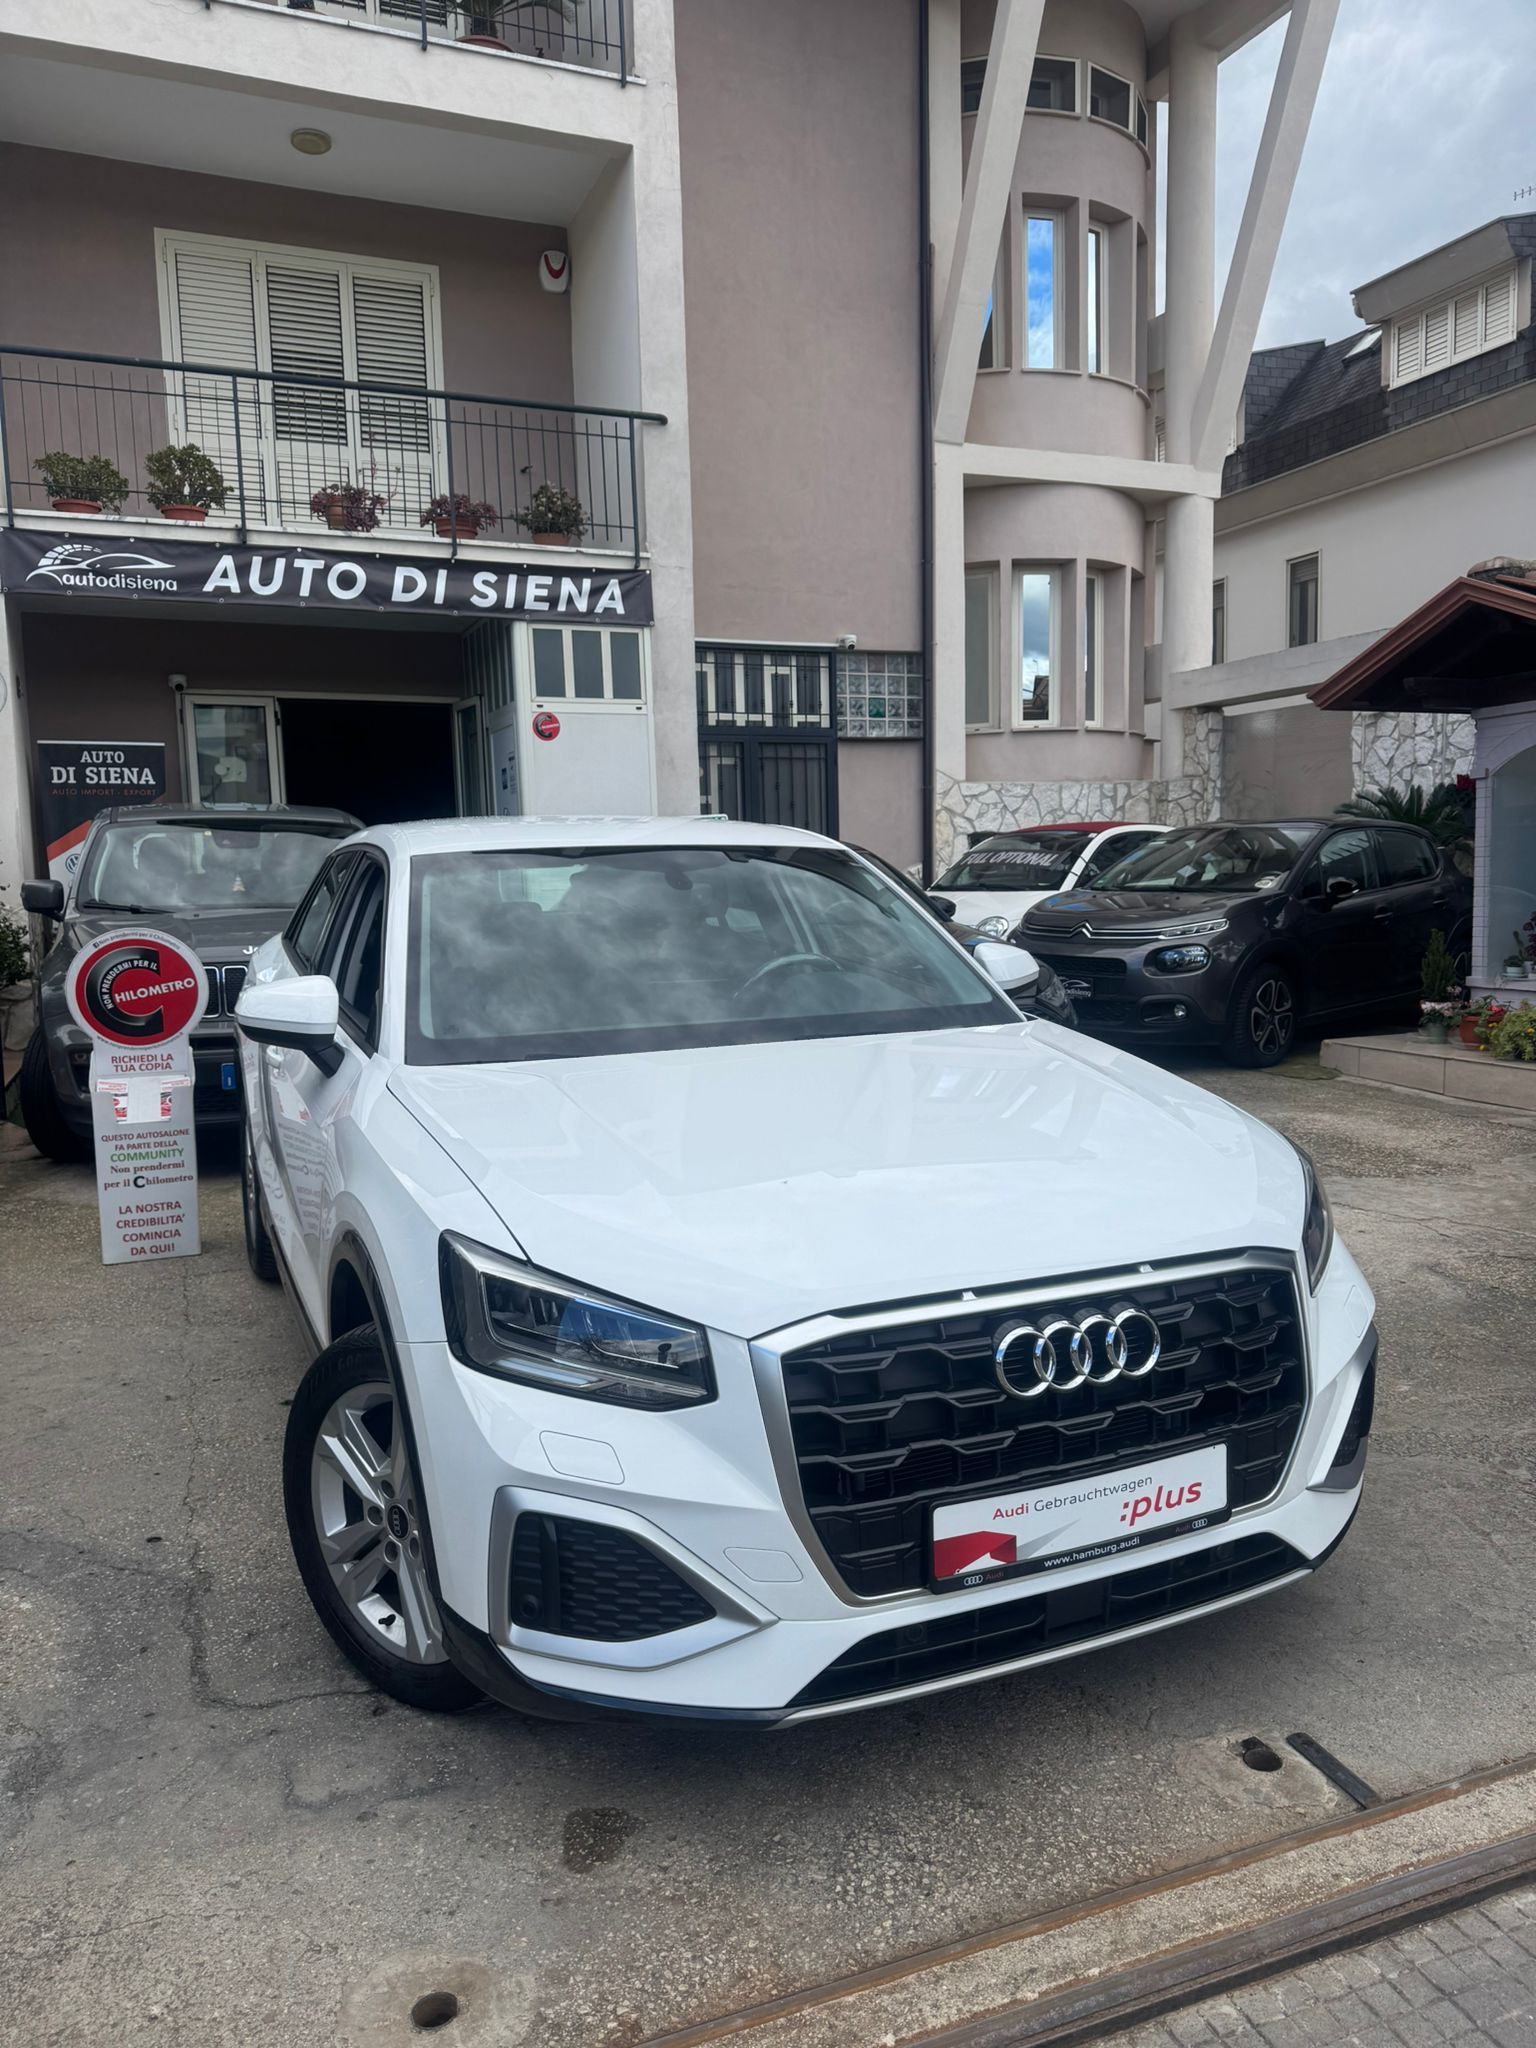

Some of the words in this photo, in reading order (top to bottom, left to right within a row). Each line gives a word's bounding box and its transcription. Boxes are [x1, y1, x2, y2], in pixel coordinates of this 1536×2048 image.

[62, 573, 178, 591] autodisiena
[202, 555, 367, 600] AUTO
[391, 566, 448, 605] DI
[470, 571, 626, 615] SIENA
[80, 751, 125, 764] AUTO
[51, 767, 77, 784] DI
[85, 767, 156, 785] SIENA
[52, 788, 77, 796] AUTO
[81, 788, 115, 796] IMPORT
[124, 788, 156, 796] EXPORT
[960, 852, 993, 866] FULL
[989, 852, 1059, 867] OPTIONAL
[133, 960, 149, 968] PER
[150, 961, 158, 970] IL
[101, 961, 133, 993] PRENDERMI
[102, 994, 114, 1010] NON
[111, 1054, 158, 1064] RICHIEDI
[160, 1053, 174, 1062] LA
[114, 1064, 137, 1073] TUA
[139, 1062, 173, 1072] COPIA
[101, 1133, 135, 1143] QUESTO
[136, 1128, 190, 1140] AUTOSALONE
[115, 1144, 125, 1152] FA
[127, 1142, 152, 1151] PARTE
[153, 1140, 178, 1148] DELLA
[110, 1148, 184, 1163] COMMUNITY
[110, 1165, 131, 1174] Non
[133, 1160, 186, 1175] prendermi
[104, 1181, 120, 1190] per
[123, 1178, 131, 1187] il
[133, 1175, 194, 1189] Chilometro
[118, 1205, 133, 1215] LA
[135, 1200, 182, 1214] NOSTRA
[122, 1228, 182, 1243] COMINCIA
[130, 1246, 147, 1256] DA
[149, 1242, 176, 1254] QUI!
[992, 1502, 1030, 1521] Audi
[1033, 1476, 1153, 1513] Gebrauchtwagen
[1119, 1481, 1203, 1527] :plus
[1043, 1536, 1141, 1568] www.hamburg.audi
[984, 1570, 1005, 1582] Audi
